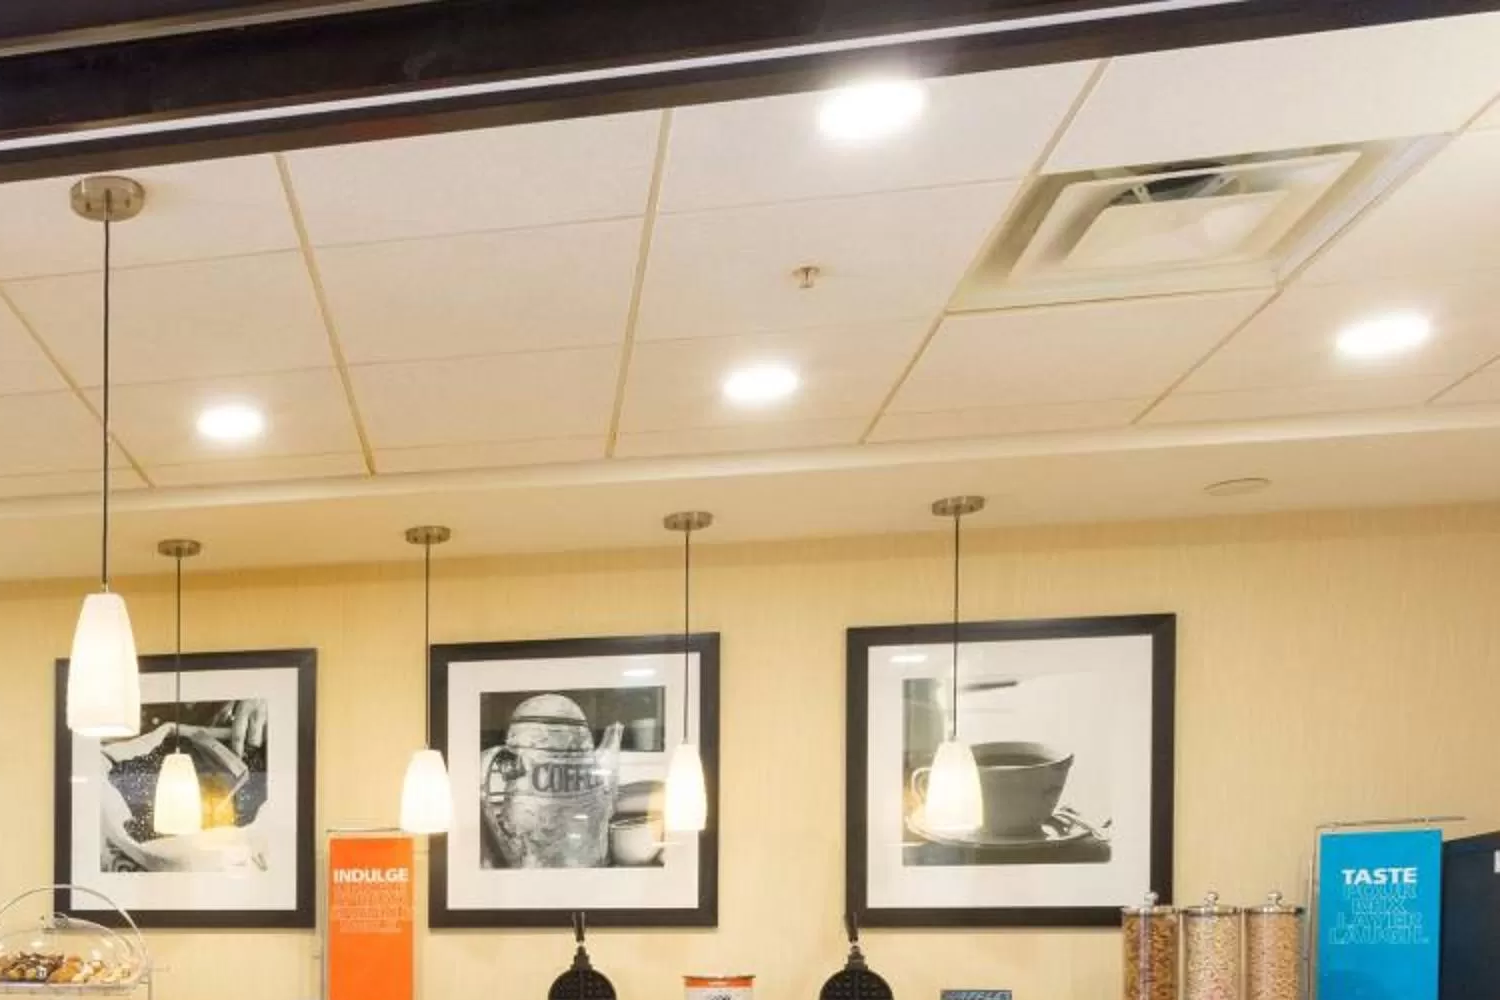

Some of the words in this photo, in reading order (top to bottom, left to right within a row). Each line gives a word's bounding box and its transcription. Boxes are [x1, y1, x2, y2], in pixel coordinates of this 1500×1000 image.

[333, 867, 409, 884] INDULGE
[1341, 866, 1418, 885] TASTE
[1343, 883, 1417, 900] POUR
[1352, 897, 1407, 914] MIX
